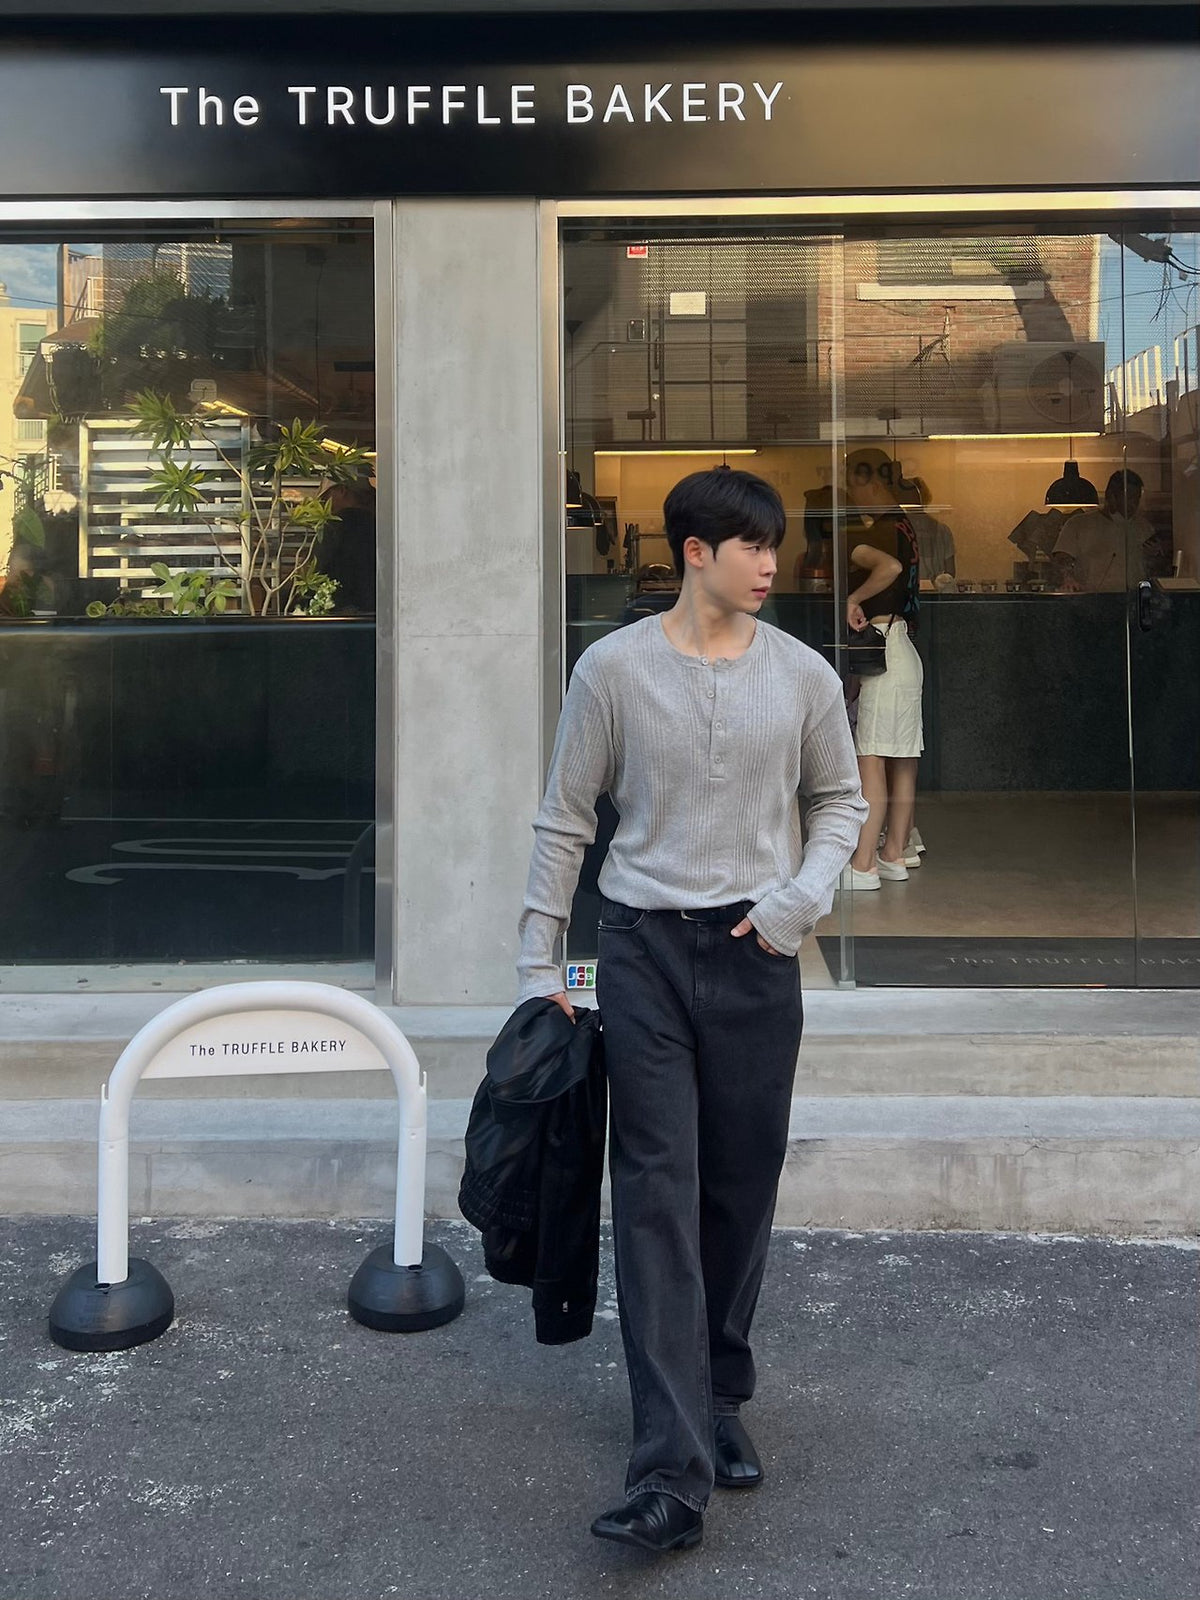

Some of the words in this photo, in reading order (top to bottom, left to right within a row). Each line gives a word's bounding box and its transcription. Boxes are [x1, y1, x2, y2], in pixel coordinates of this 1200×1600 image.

[159, 86, 260, 126] The
[287, 84, 537, 126] TRUFFLE
[565, 81, 784, 125] BAKERY
[190, 1044, 216, 1056] The
[222, 1041, 285, 1055] TRUFFLE
[291, 1040, 347, 1053] BAKERY
